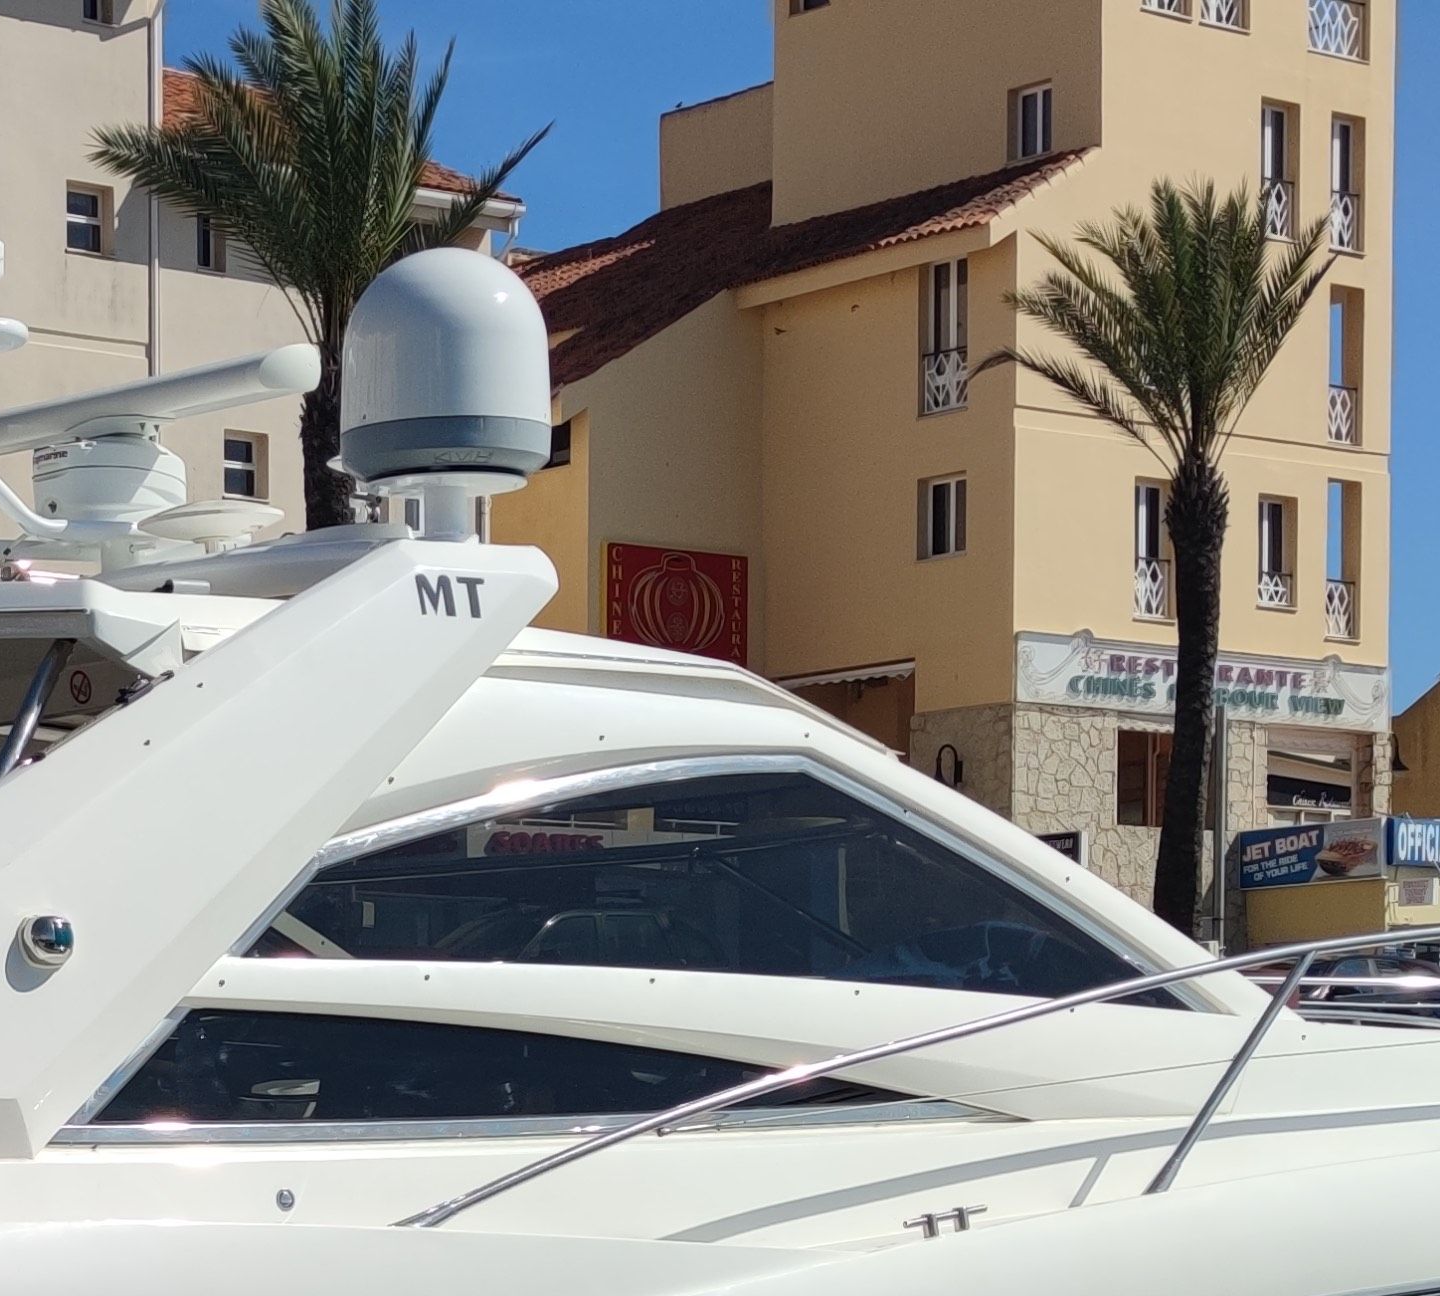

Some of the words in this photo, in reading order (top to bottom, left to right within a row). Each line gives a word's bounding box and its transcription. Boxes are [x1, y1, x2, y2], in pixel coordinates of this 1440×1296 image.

[434, 451, 494, 465] KVH
[414, 573, 485, 619] MT
[1108, 653, 1307, 690] RESTRANTE
[1288, 694, 1346, 716] VIEW
[1242, 842, 1271, 862] JET
[1275, 830, 1319, 855] BOAT
[1243, 865, 1259, 875] FOR
[1260, 859, 1277, 871] THE
[1278, 854, 1299, 866] RIDE
[1253, 873, 1264, 882] OF
[1266, 867, 1289, 878] YOUR
[1290, 861, 1309, 873] LIFE
